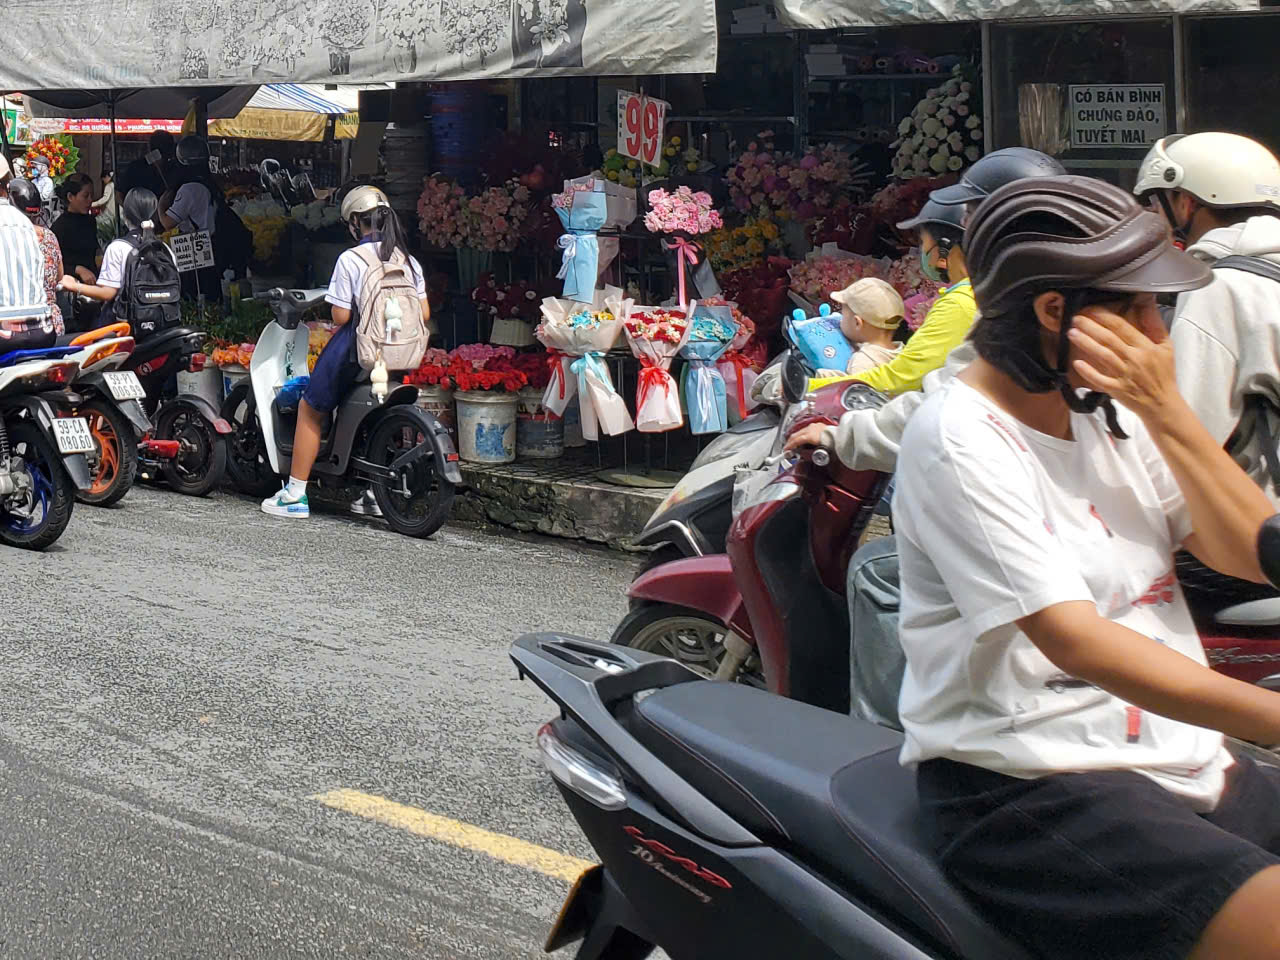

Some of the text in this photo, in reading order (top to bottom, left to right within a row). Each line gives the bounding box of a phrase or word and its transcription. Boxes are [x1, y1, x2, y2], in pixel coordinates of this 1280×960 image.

[1075, 87, 1161, 103] CÓ BÁN BÌNH
[1077, 108, 1122, 122] CHƯNG
[1076, 124, 1146, 143] TUYẾT MAI
[57, 420, 85, 435] 59-CA
